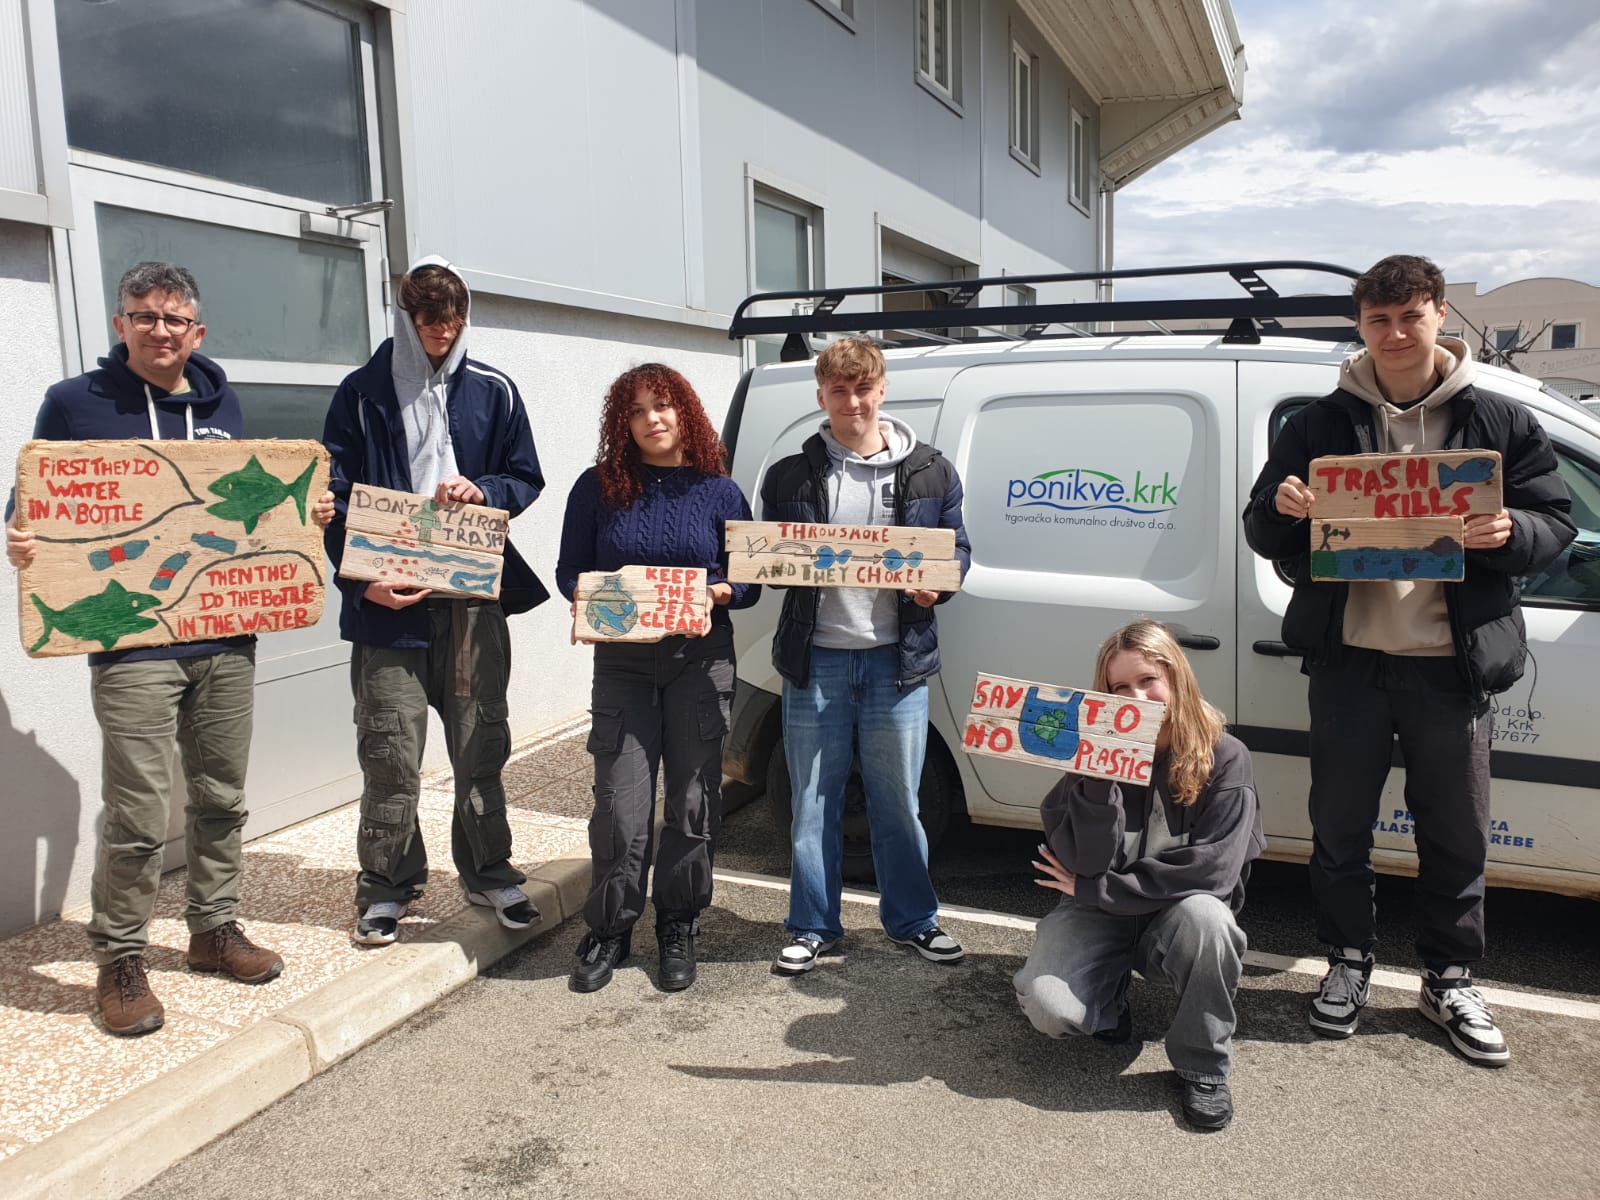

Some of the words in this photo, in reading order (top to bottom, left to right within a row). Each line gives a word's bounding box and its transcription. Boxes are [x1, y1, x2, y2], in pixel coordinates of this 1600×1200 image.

[90, 457, 131, 476] THEY
[132, 459, 159, 477] DO
[1316, 457, 1429, 497] TRASH
[46, 481, 120, 499] WATER
[55, 501, 72, 520] A
[75, 503, 143, 525] BOTTLE
[1374, 486, 1474, 519] KILLS
[1005, 512, 1052, 525] trgovačko
[1053, 515, 1107, 527] komunalno
[1109, 517, 1146, 529] društvo
[1147, 519, 1177, 531] d.o.o.
[442, 527, 504, 548] TRASH
[205, 569, 252, 586] THEN
[250, 563, 298, 583] THEY
[645, 567, 698, 586] KEEP
[802, 565, 849, 583] THEY
[856, 566, 924, 584] CHOKE!
[199, 592, 224, 611] DO
[227, 590, 259, 608] THE
[654, 584, 695, 602] THE
[655, 597, 695, 617] SEA
[202, 612, 237, 635] THE
[237, 608, 309, 632] WATER
[639, 611, 703, 632] CLEAN
[973, 680, 1024, 709] SAY
[1084, 698, 1141, 734] TO
[1507, 719, 1534, 732] Krk
[964, 724, 1014, 753] NO
